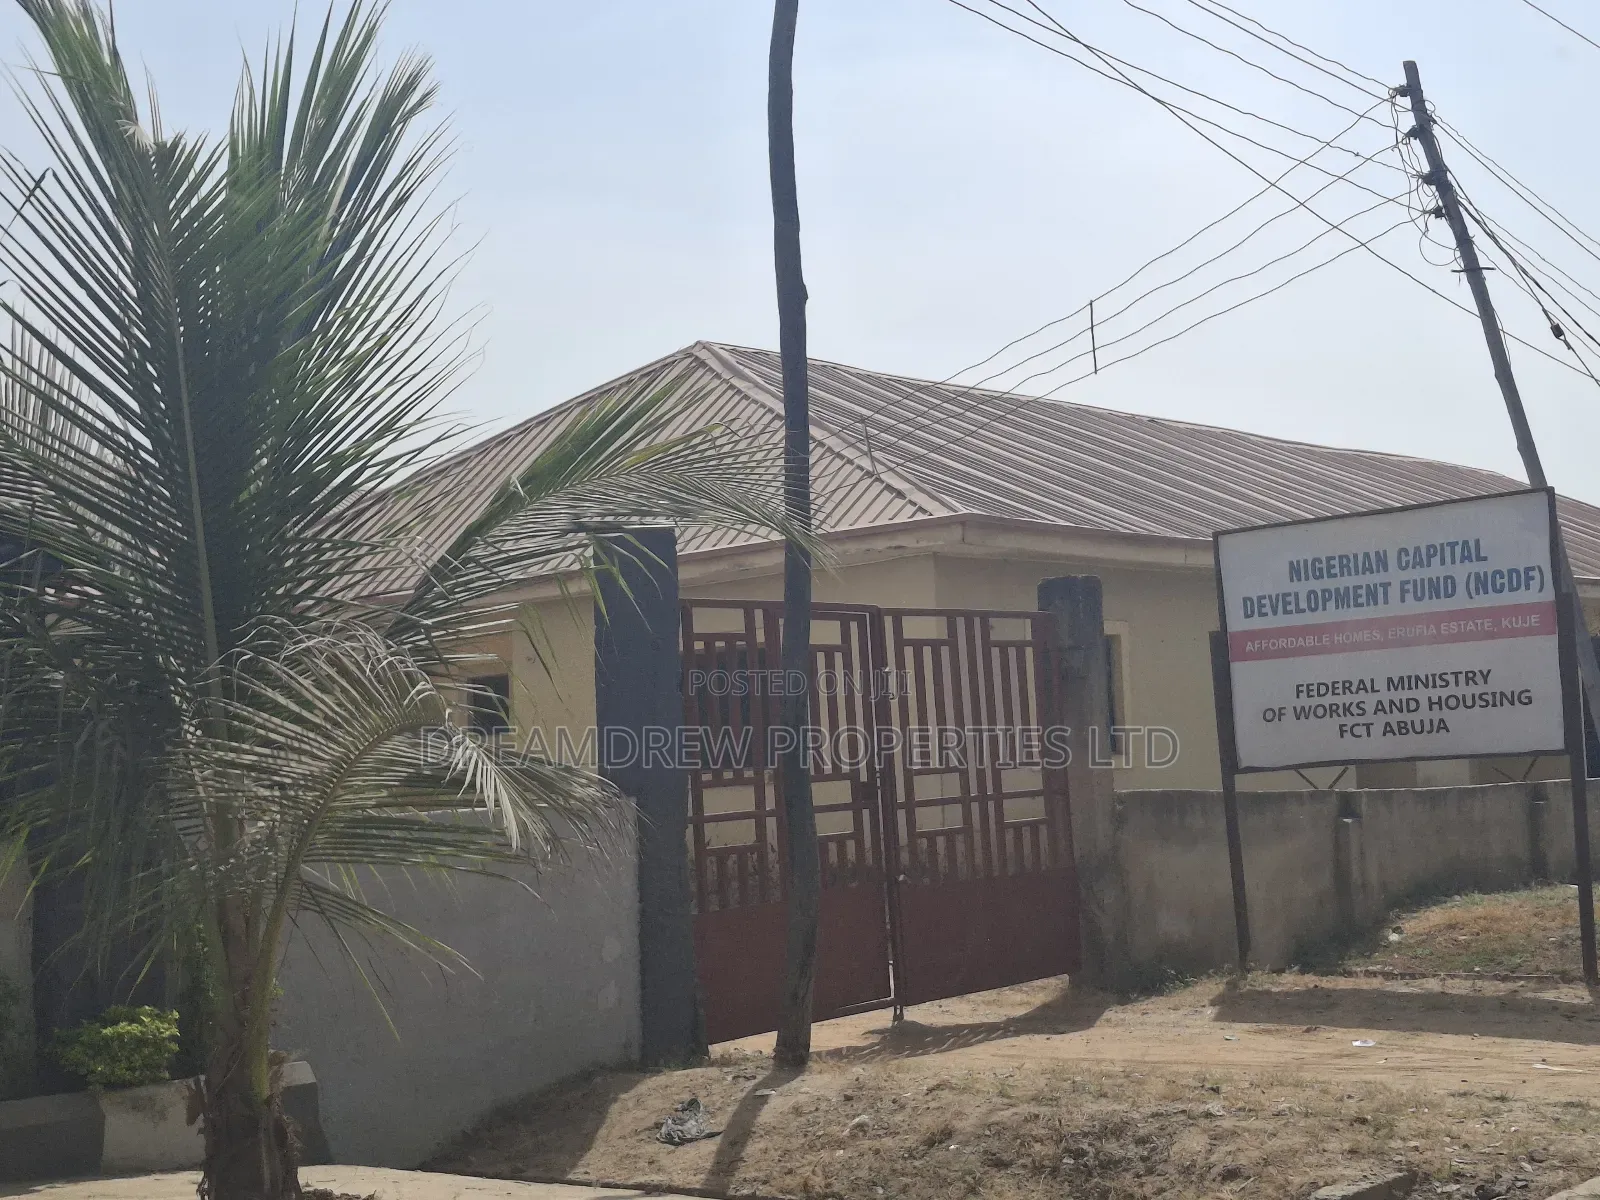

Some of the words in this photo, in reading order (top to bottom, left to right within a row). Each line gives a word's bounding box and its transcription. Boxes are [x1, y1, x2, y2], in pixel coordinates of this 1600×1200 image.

[1288, 549, 1389, 583] NIGERIAN
[1396, 538, 1488, 572] CAPITAL
[1241, 582, 1391, 619] DEVELOPMENT
[1399, 574, 1457, 604] FUND
[1465, 565, 1545, 600] (NCDF)
[1245, 634, 1330, 653] AFFORDABLE
[1334, 629, 1384, 646] HOMES,
[1441, 619, 1497, 635] ESTATE,
[1501, 614, 1541, 629] KUJE
[1295, 679, 1381, 699] FEDERAL
[1386, 669, 1492, 693] MINISTRY
[1262, 708, 1286, 723] OF
[1293, 701, 1367, 721] WORKS
[1373, 697, 1421, 717] AND
[1427, 689, 1533, 712] HOUSING
[1338, 723, 1375, 739] FCT
[1381, 718, 1451, 738] ABUJA
